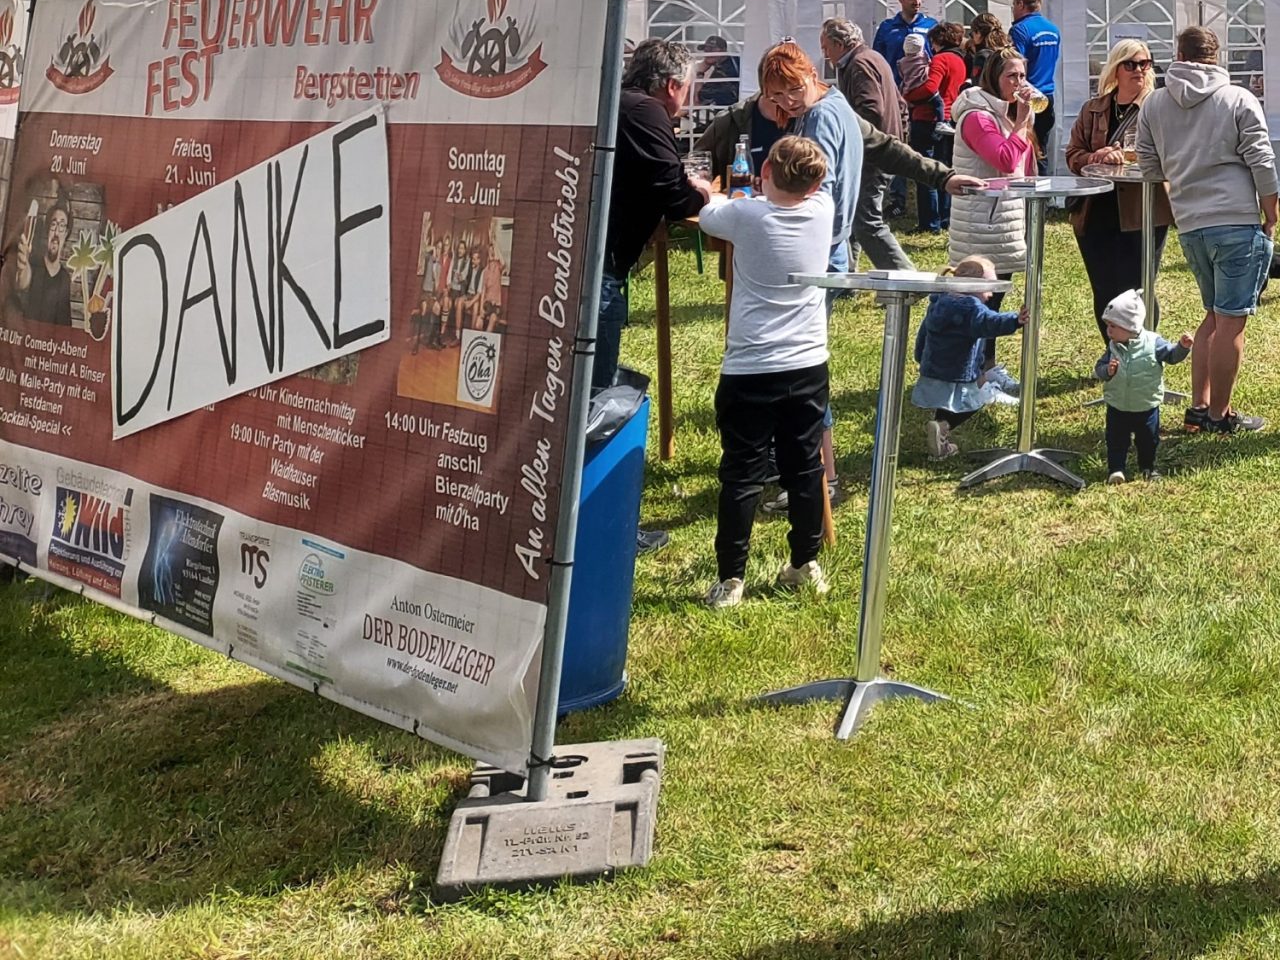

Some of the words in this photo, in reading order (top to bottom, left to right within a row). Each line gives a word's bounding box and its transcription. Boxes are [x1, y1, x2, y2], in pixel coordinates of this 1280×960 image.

[145, 43, 222, 116] FEST
[293, 65, 420, 108] Bergstetten
[50, 129, 102, 155] Donnerstag
[172, 137, 212, 162] Freitag
[51, 155, 63, 173] 20.
[66, 157, 86, 176] Juni
[165, 165, 184, 184] 21.
[187, 162, 216, 186] Juni
[448, 147, 506, 177] Sonntag
[446, 181, 466, 204] 23.
[470, 183, 500, 206] Juni
[539, 146, 581, 328] Barbetrieb!
[118, 115, 385, 425] DANKE
[10, 330, 22, 346] Uhr
[24, 334, 88, 359] Comedy-Abend
[6, 368, 17, 384] Uhr
[20, 372, 65, 397] Malle-Party
[67, 383, 80, 398] mit
[82, 388, 96, 403] den
[24, 355, 37, 369] mit
[38, 356, 68, 376] Helmut
[69, 365, 78, 377] A.
[80, 365, 105, 384] Binser
[530, 336, 564, 423] Tagen
[20, 393, 63, 416] Festdamen
[260, 388, 276, 403] Uhr
[279, 388, 357, 425] Kindernachmittag
[230, 423, 252, 443] 19:00
[255, 430, 271, 448] Uhr
[273, 435, 295, 459] Party
[297, 443, 310, 461] mit
[310, 447, 324, 465] der
[277, 414, 290, 429] mit
[292, 416, 365, 449] Menschenkicker
[384, 411, 416, 433] 14:00
[418, 417, 440, 438] Uhr
[442, 422, 488, 454] Festzug
[270, 458, 317, 488] Waidhauser
[437, 452, 483, 475] anschl.
[521, 437, 551, 522] allen
[262, 481, 311, 510] Blasmusik
[435, 474, 510, 515] Bierzeltparty
[74, 492, 124, 560] Wild
[436, 504, 453, 522] mit
[516, 527, 545, 580] An
[390, 595, 421, 617] Anton
[424, 603, 475, 634] Ostermeier
[363, 613, 393, 648] DER
[397, 623, 495, 686] BODENLEGER
